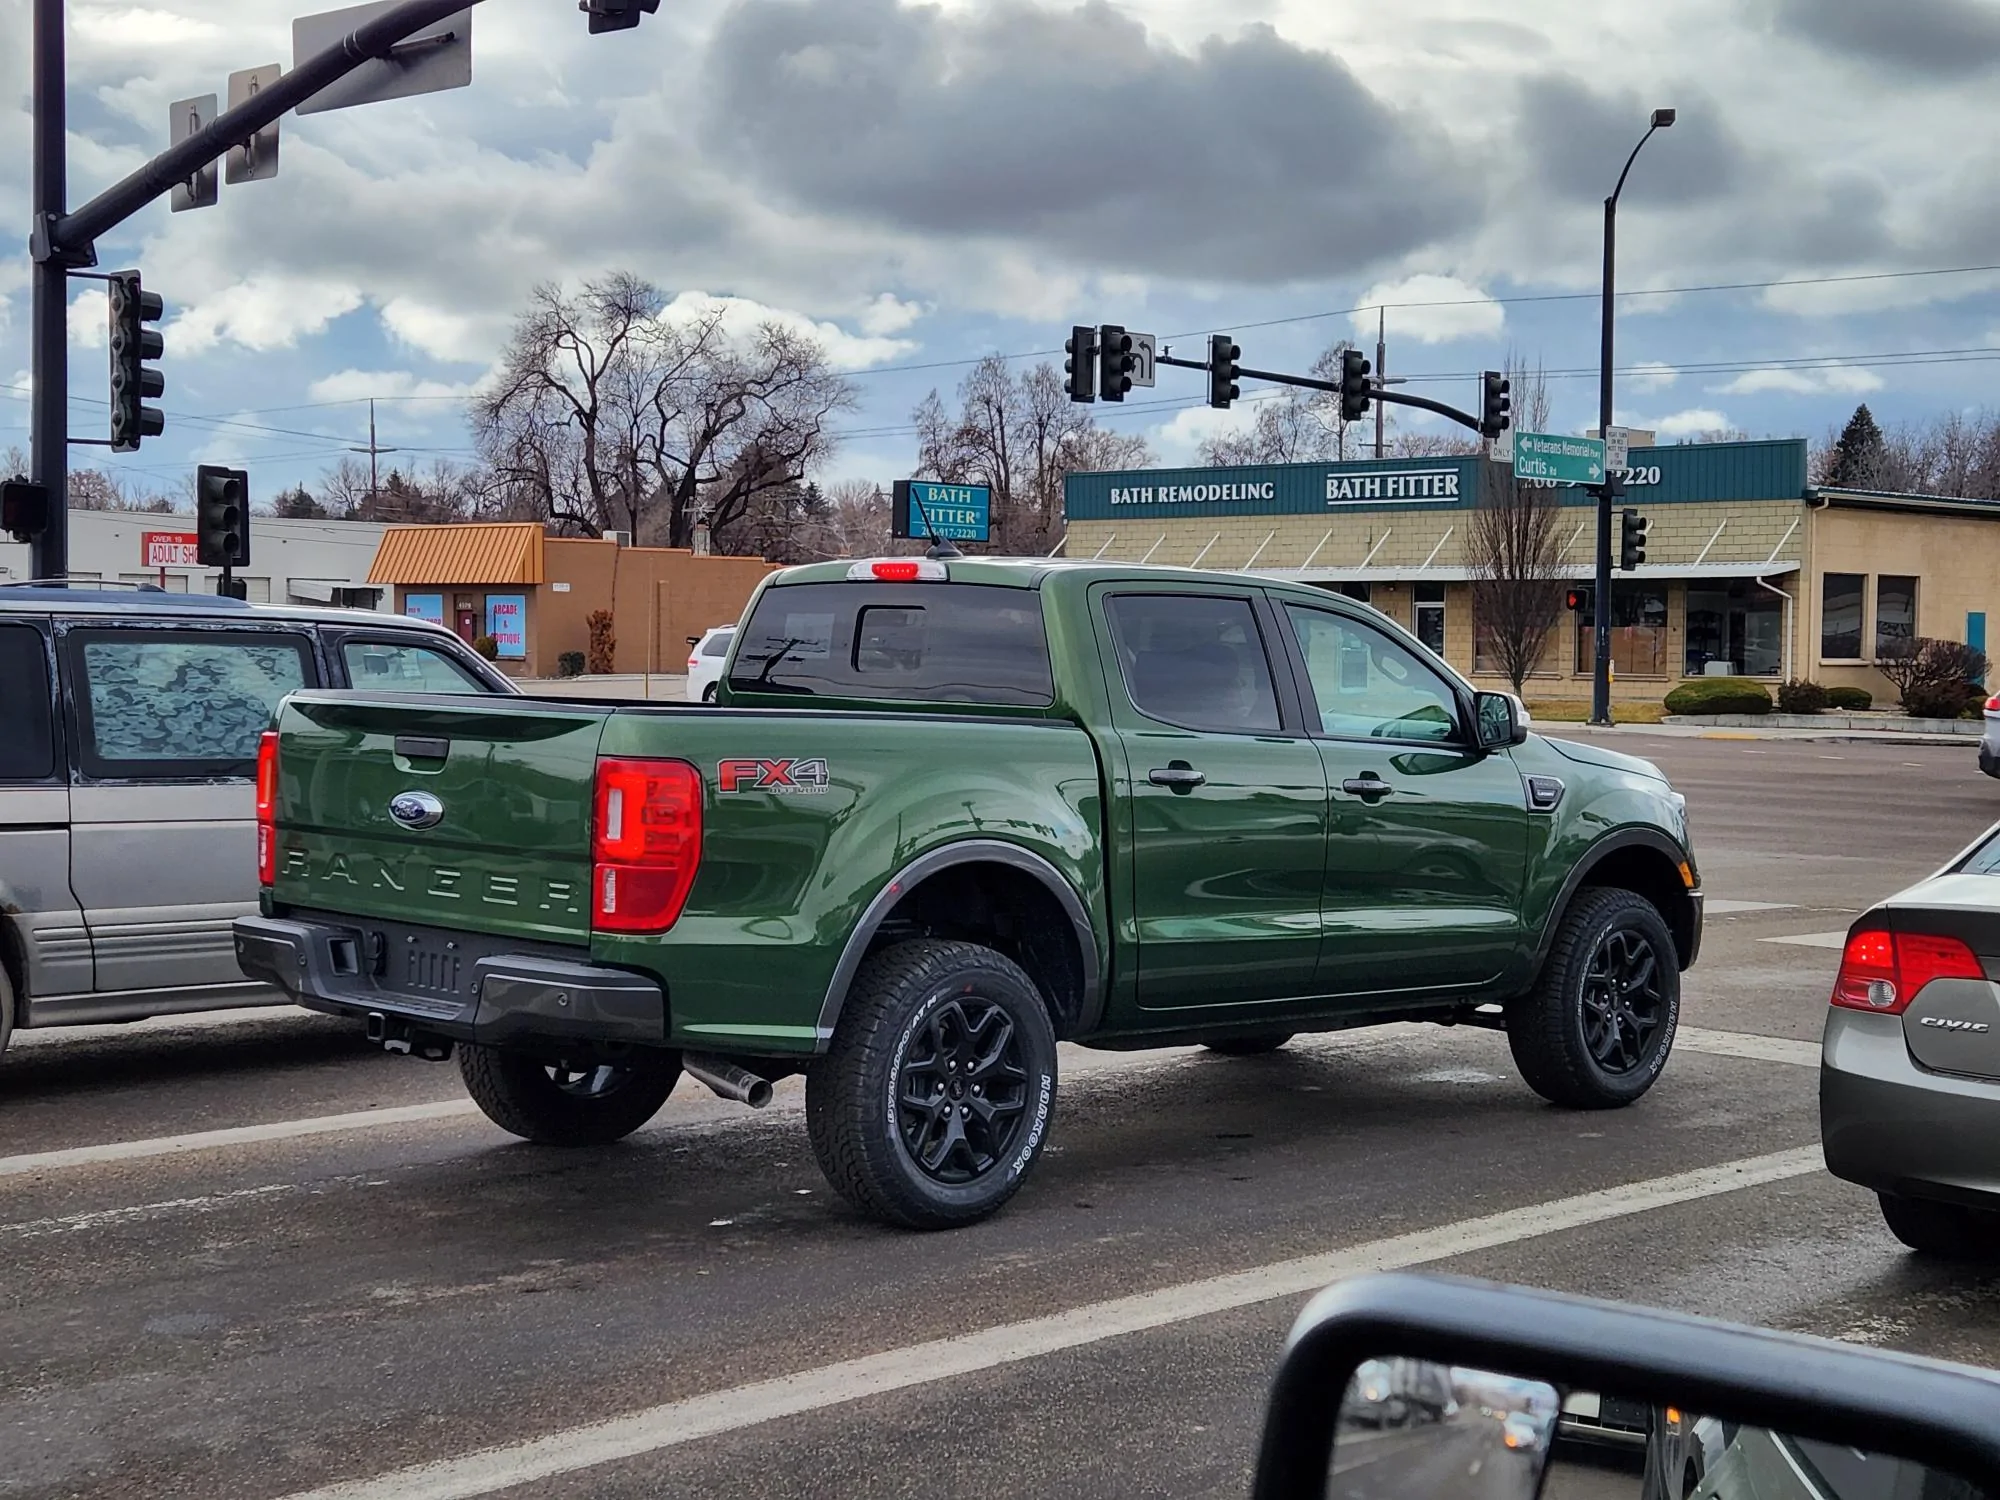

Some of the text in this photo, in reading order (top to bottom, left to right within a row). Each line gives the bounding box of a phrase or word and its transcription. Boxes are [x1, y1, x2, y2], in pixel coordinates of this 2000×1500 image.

[1493, 447, 1510, 457] ONLY
[1533, 438, 1562, 454] Veterans
[1562, 440, 1590, 457] Memorial
[1519, 456, 1557, 476] Curtis Rd
[928, 487, 971, 503] BATH
[1110, 482, 1274, 504] BATH REMODELING
[1326, 474, 1459, 499] BATH FITTER
[152, 535, 172, 543] OVER
[152, 545, 198, 564] ADULT SHO
[493, 604, 517, 615] ARCADE
[717, 758, 829, 794] FX4
[281, 846, 579, 913] RANGER
[1920, 1016, 1990, 1033] CIVIC
